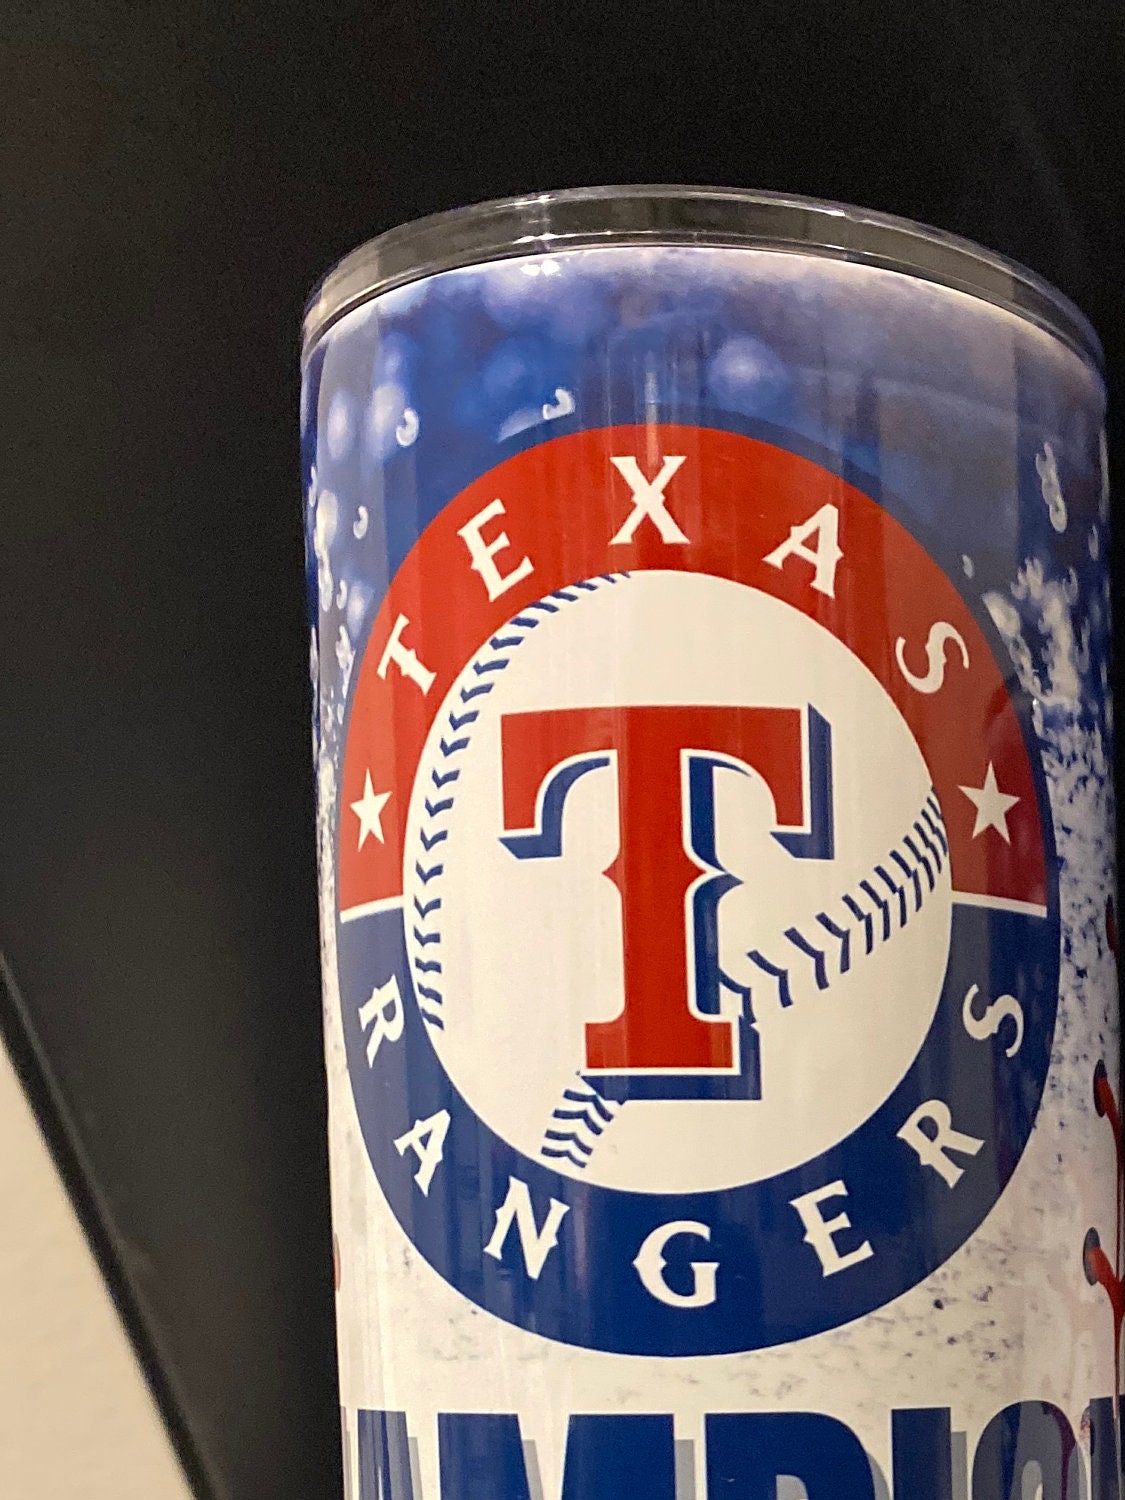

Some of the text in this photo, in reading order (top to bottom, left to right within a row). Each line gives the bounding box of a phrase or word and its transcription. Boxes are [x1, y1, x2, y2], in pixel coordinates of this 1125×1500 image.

[378, 455, 970, 696] TEXAS
[498, 704, 840, 1102] T
[358, 976, 1025, 1309] RANGERS
